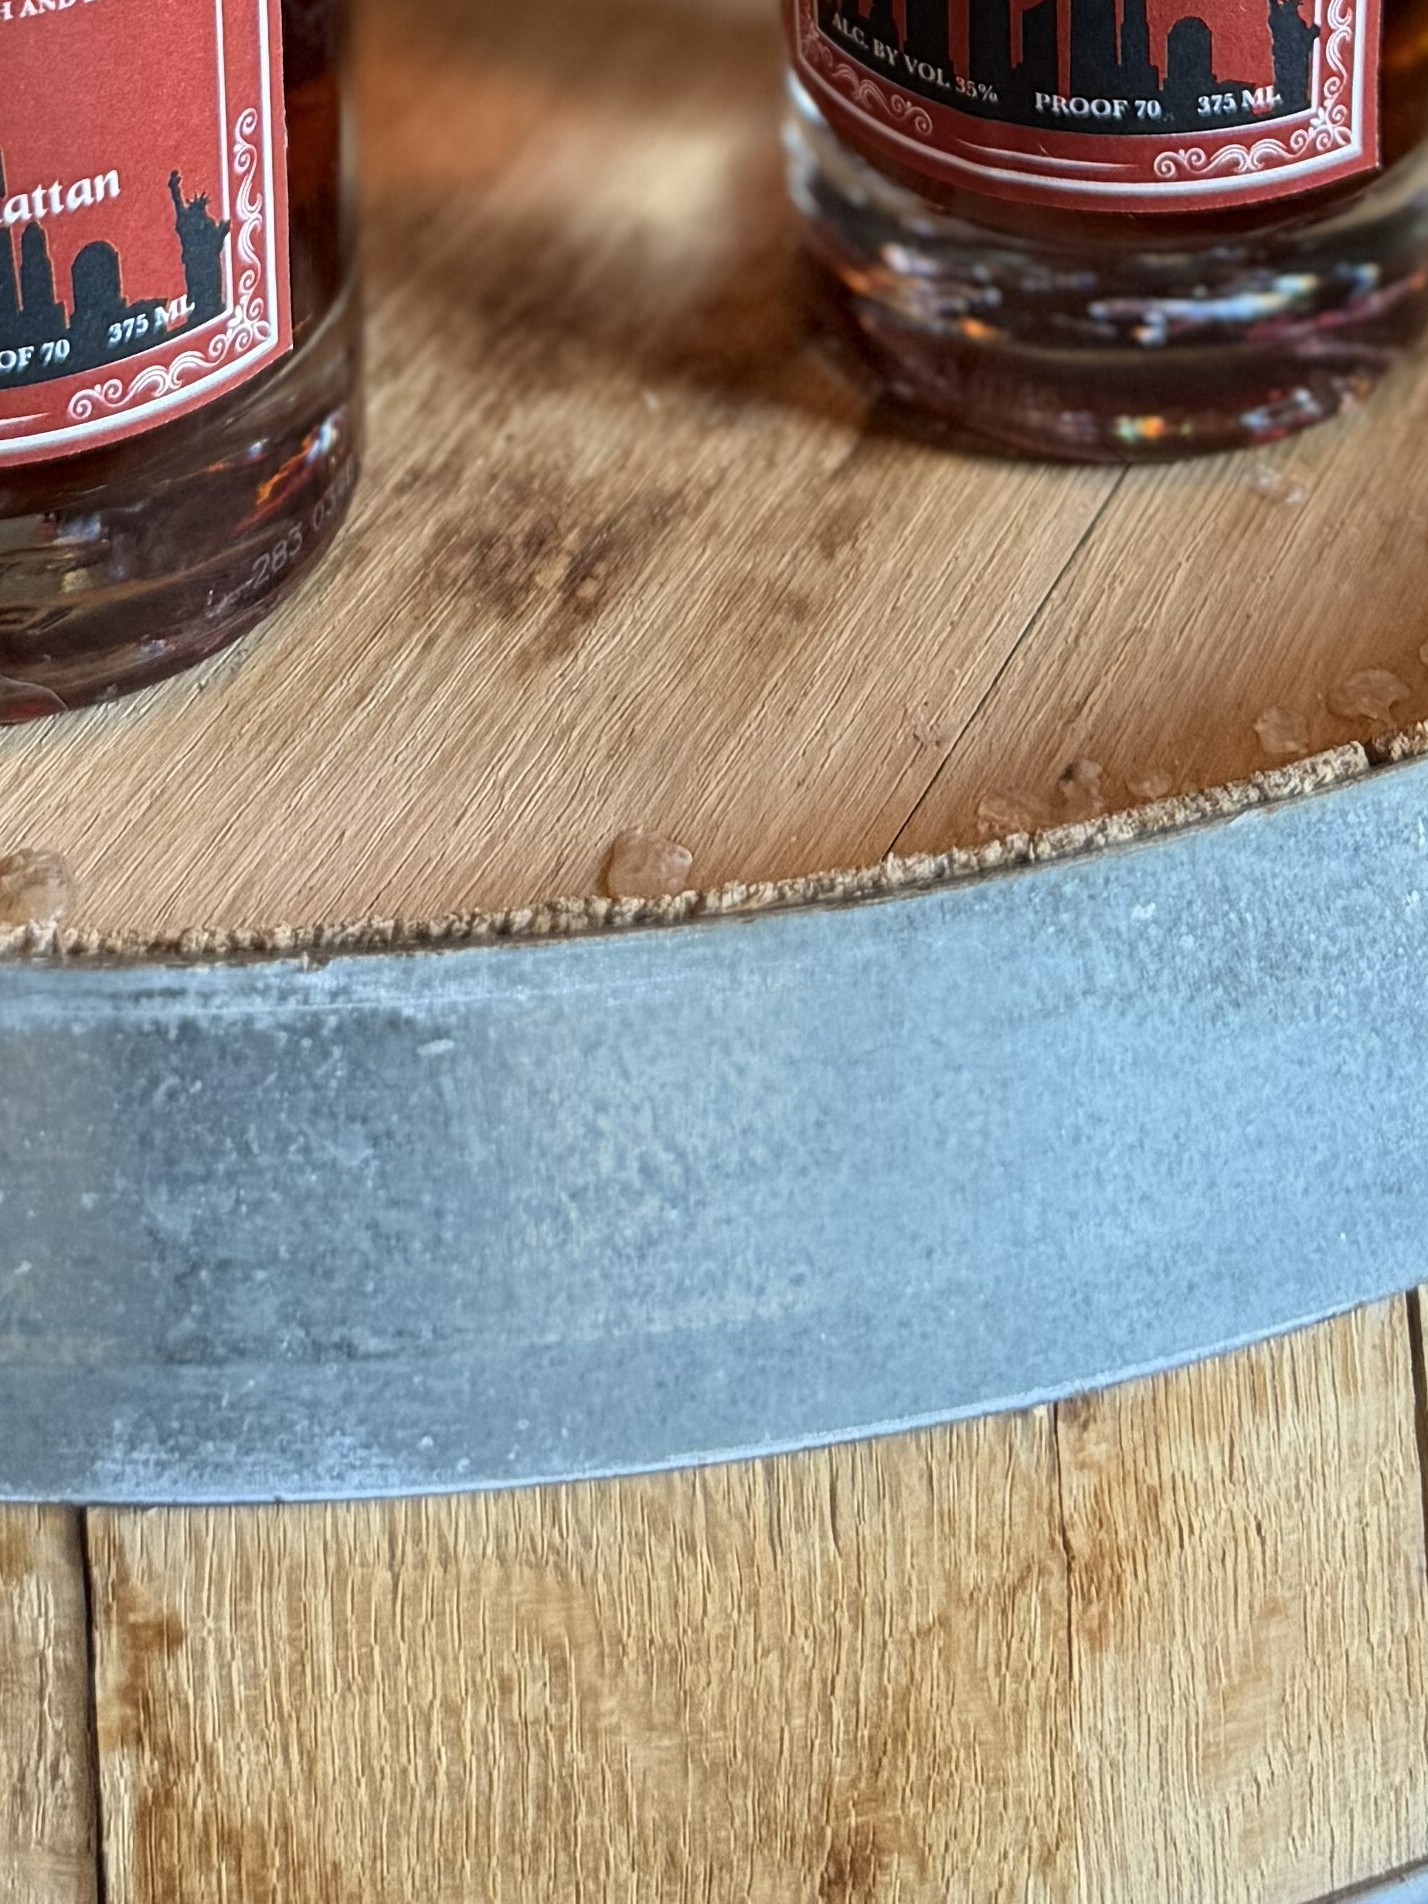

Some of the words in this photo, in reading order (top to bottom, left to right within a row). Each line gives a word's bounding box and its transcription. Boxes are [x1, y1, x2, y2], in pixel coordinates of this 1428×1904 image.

[873, 38, 899, 67] BY
[903, 54, 950, 90] VOL
[955, 75, 999, 103] 35%
[1034, 91, 1130, 120] PROOF
[1134, 97, 1162, 119] 70
[1197, 93, 1236, 115] 375
[1240, 85, 1283, 113] ML
[41, 338, 71, 365] 70
[108, 312, 149, 346] 375
[153, 295, 197, 331] ML
